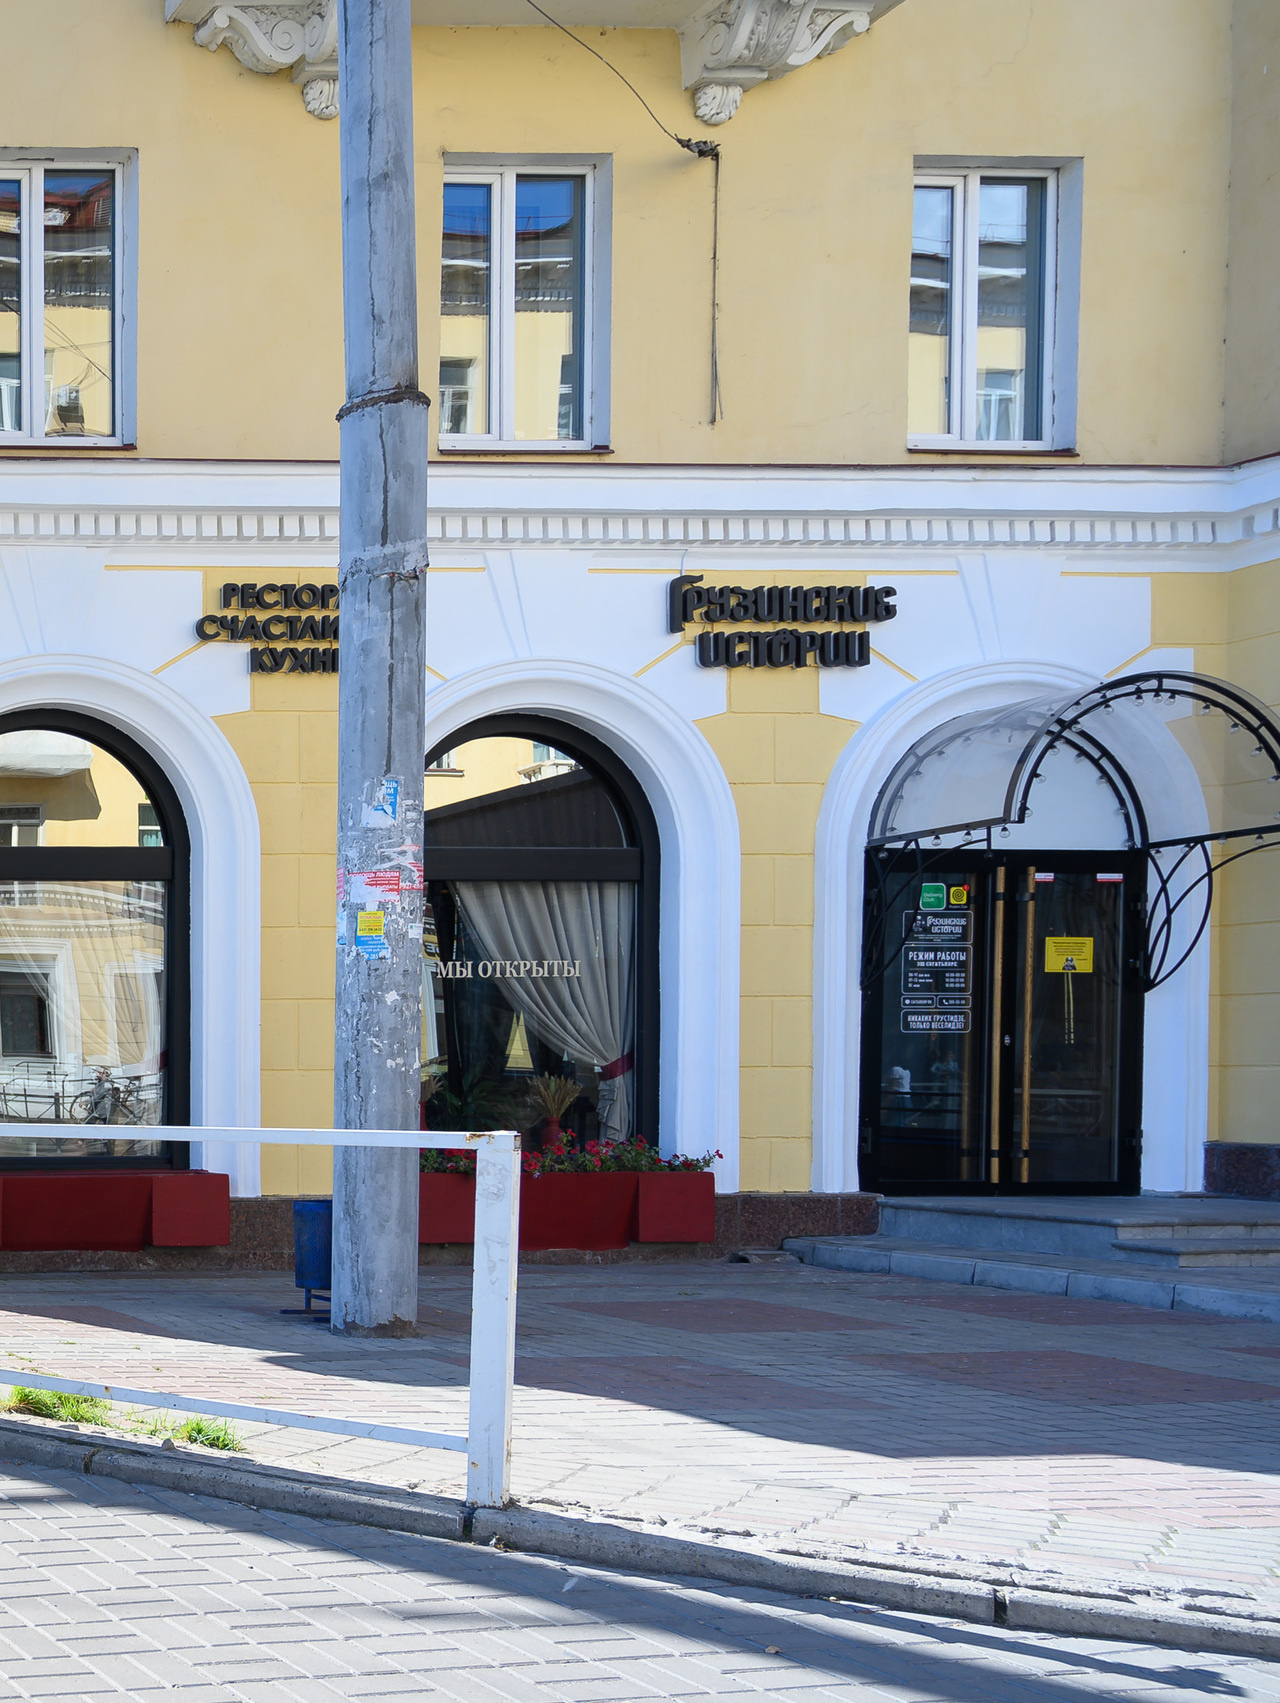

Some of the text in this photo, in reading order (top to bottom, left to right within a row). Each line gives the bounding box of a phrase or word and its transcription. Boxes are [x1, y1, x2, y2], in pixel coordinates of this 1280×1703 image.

[221, 583, 339, 610] РЕСТОР
[194, 614, 339, 642] СЧАСТЛИ
[908, 951, 967, 961] РЕЖИМ РАБОТЫ
[436, 960, 582, 979] МЫ ОТКРЫТЫ
